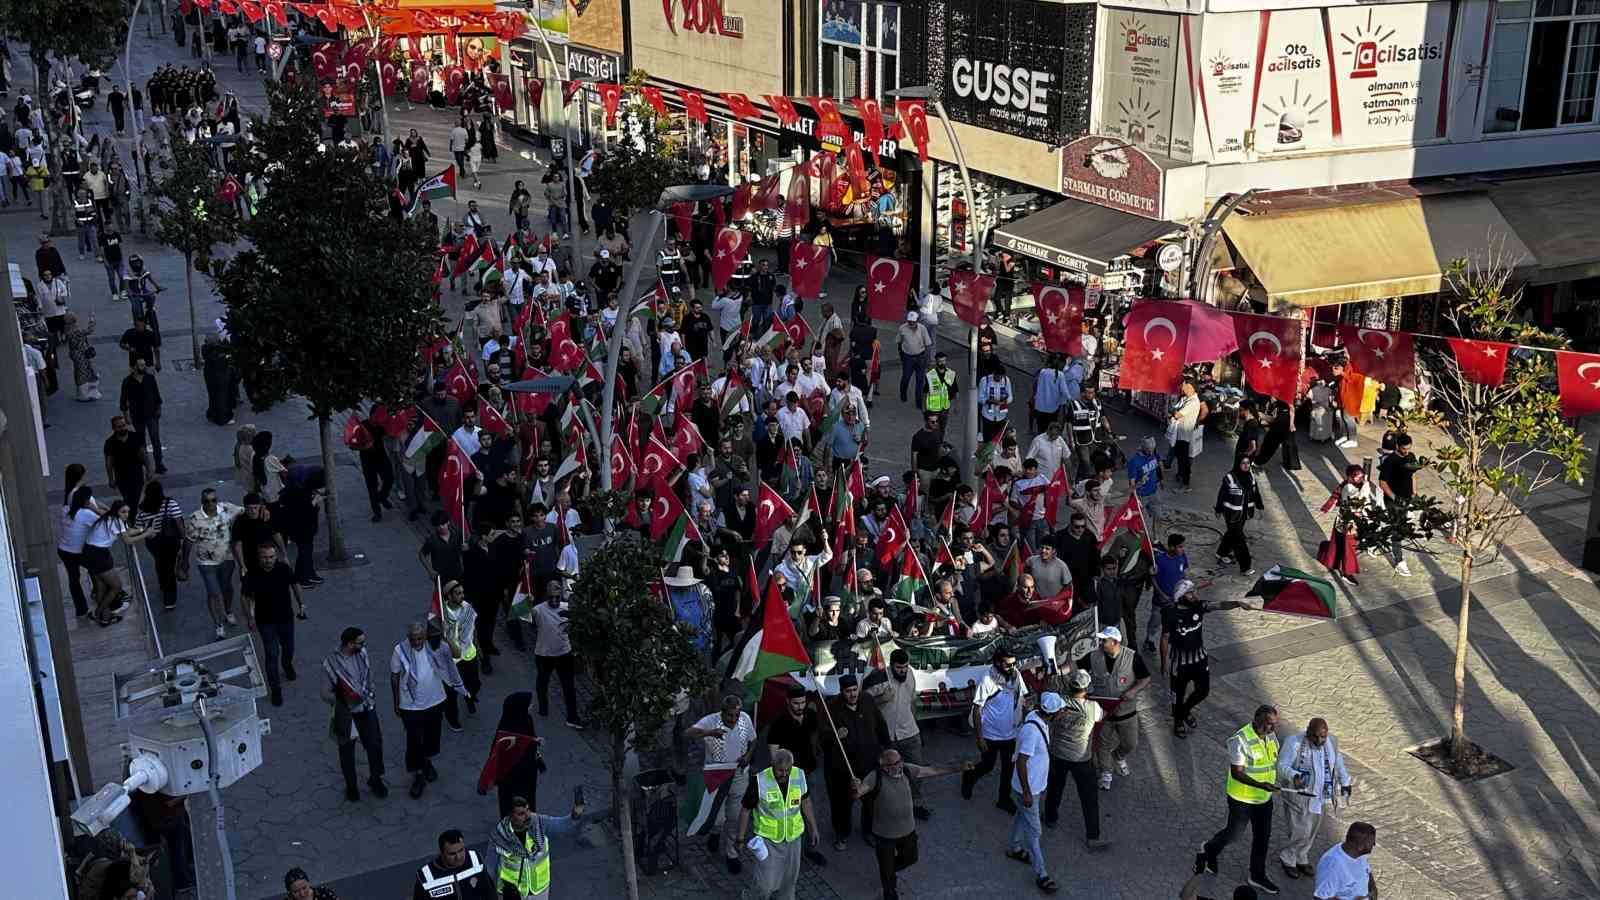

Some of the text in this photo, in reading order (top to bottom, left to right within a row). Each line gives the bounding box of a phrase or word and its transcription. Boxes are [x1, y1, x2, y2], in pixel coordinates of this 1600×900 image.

[1285, 43, 1307, 55] Oto
[1268, 56, 1321, 72] acilsatis
[952, 57, 1049, 114] GUSSE
[1362, 98, 1410, 109] satmanın
[990, 107, 1048, 128] made with gusto
[1368, 115, 1393, 127] kolay
[1109, 188, 1155, 212] COSMETIC
[1056, 254, 1089, 272] COSMETIC
